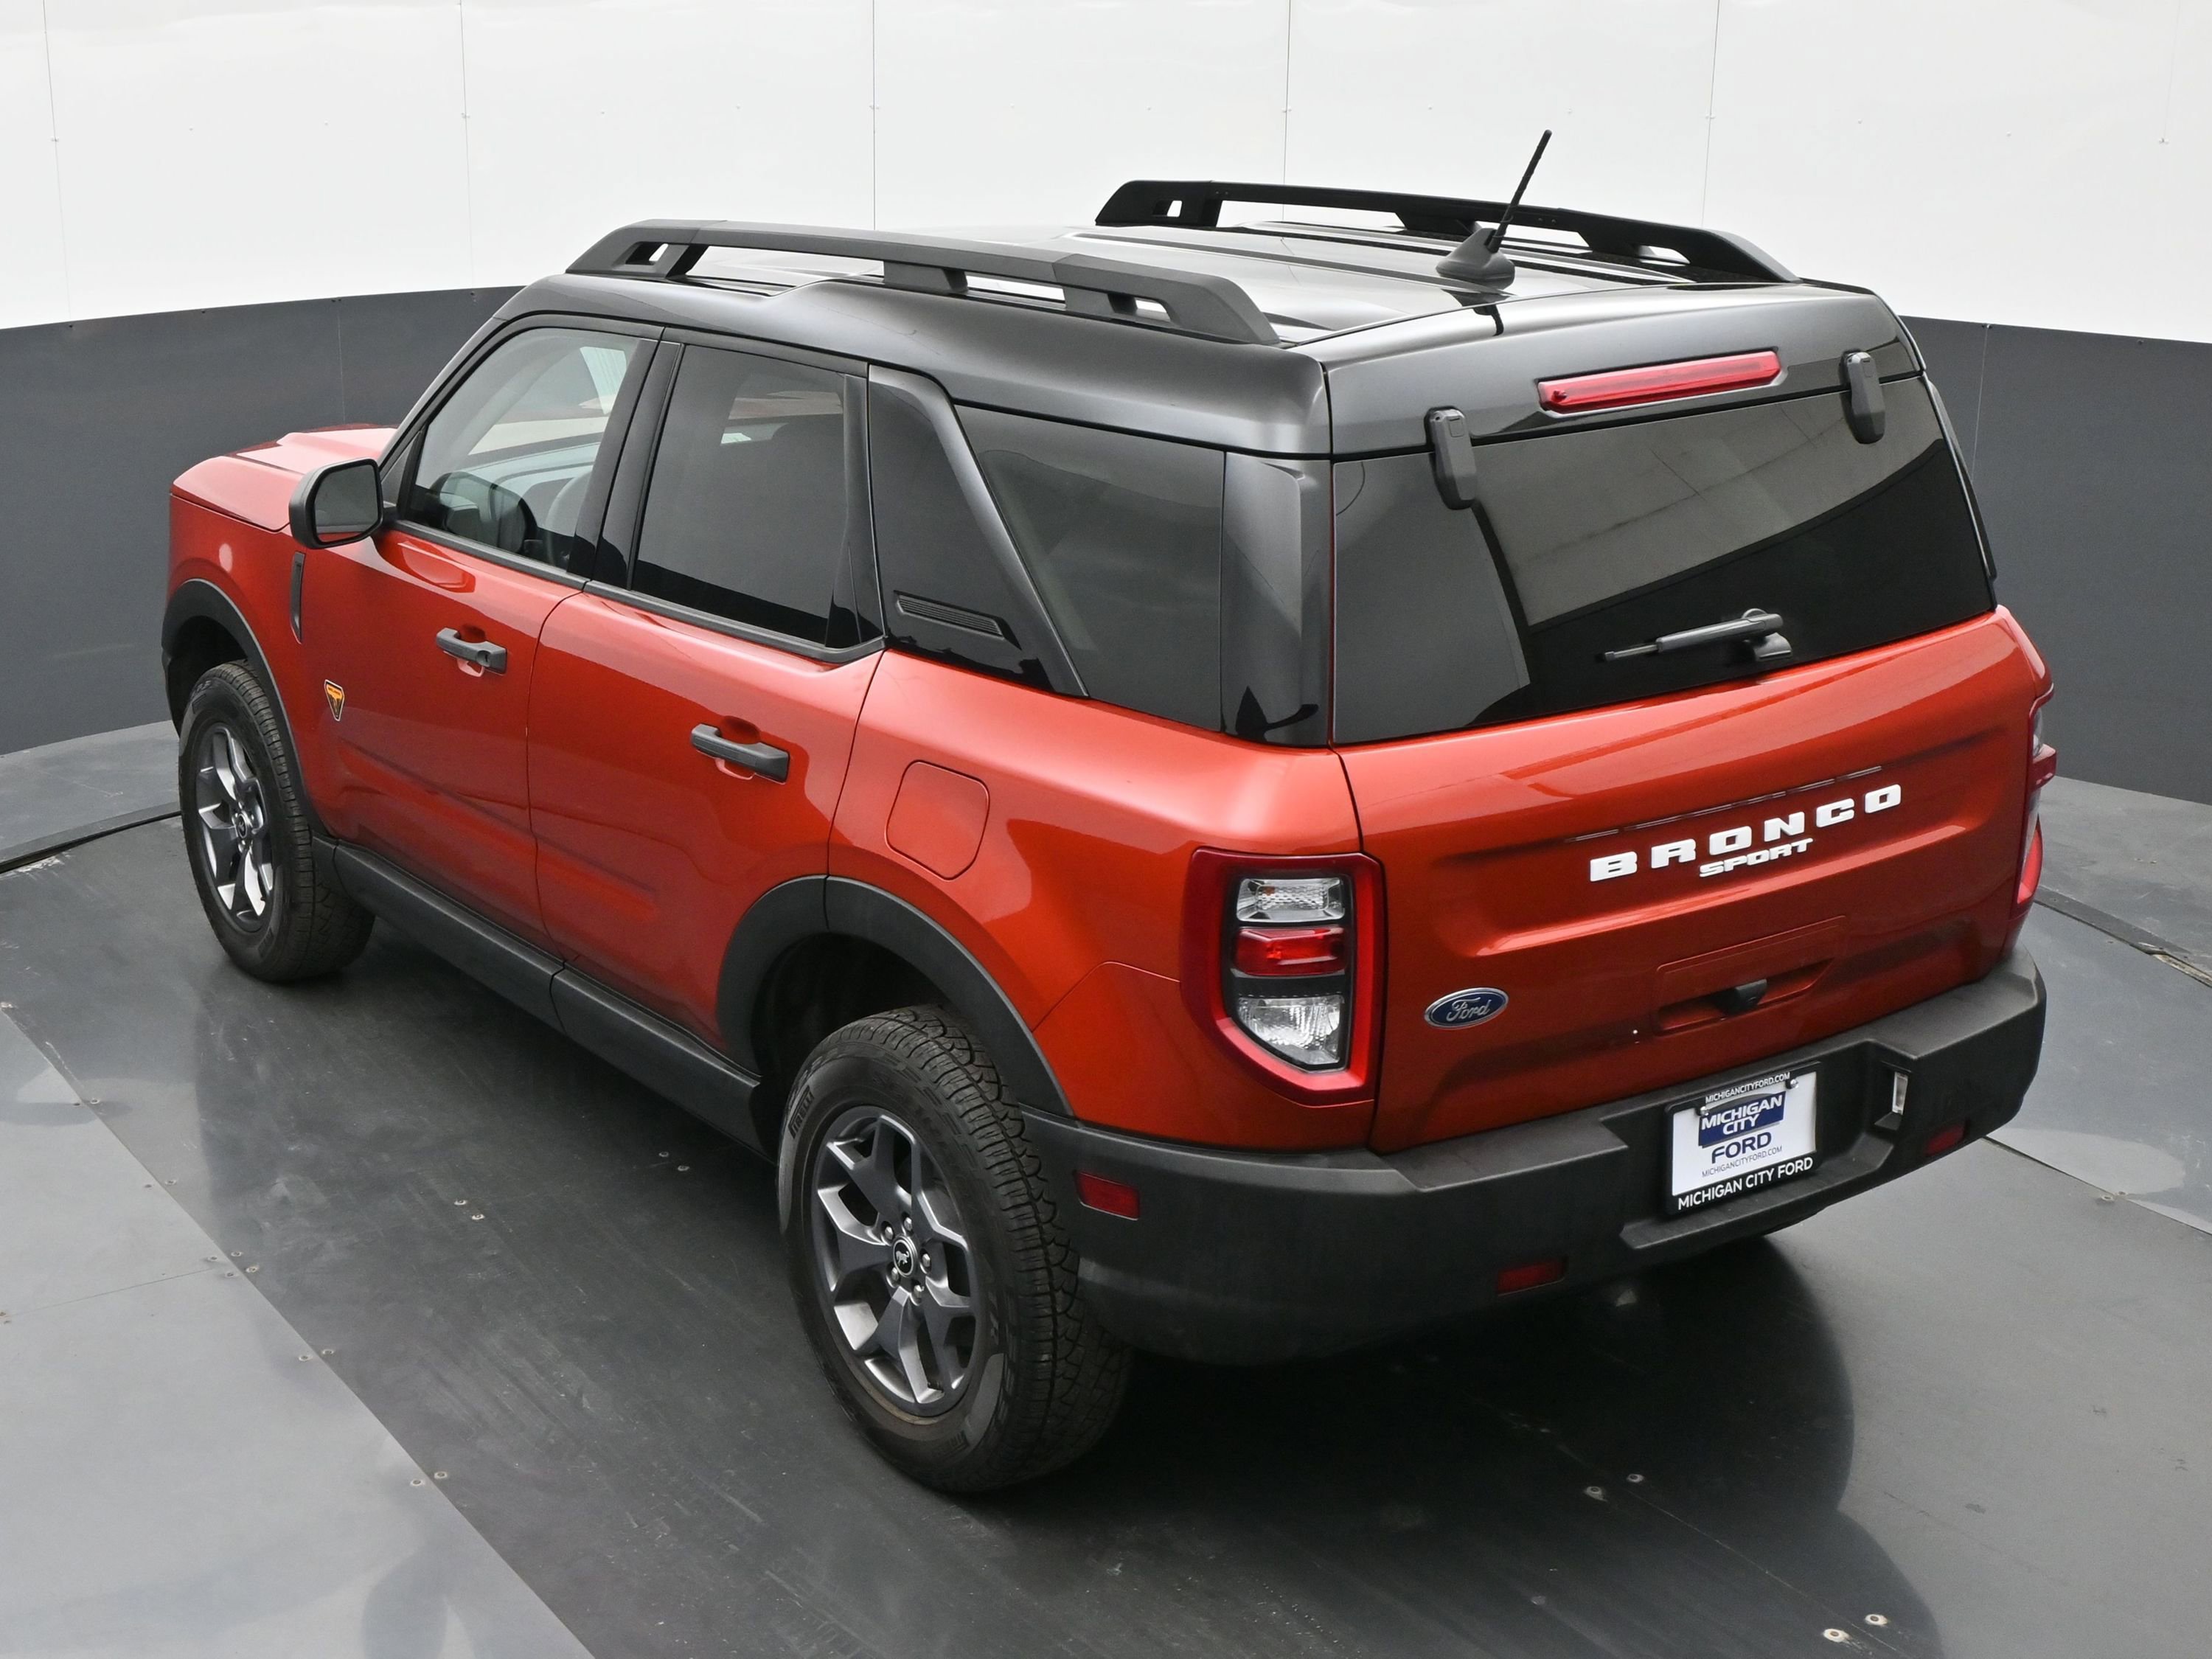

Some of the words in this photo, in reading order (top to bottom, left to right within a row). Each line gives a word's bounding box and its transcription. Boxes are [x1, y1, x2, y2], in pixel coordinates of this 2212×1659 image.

[1590, 784, 1902, 882] BRONCO
[1699, 838, 1814, 877] SPORT
[1446, 997, 1492, 1022] Ford
[1705, 1072, 1790, 1104] MICHIGANCITYFORD.COM
[1701, 1095, 1783, 1130] MICHIGAN
[1722, 1113, 1761, 1135] CITY
[1701, 1145, 1783, 1178] MICHIGANCITYFORD.COM
[1711, 1132, 1772, 1164] FORD
[1678, 1178, 1742, 1211] MICHIGAN
[1745, 1167, 1775, 1189] CITY
[1778, 1156, 1814, 1179] FORD
